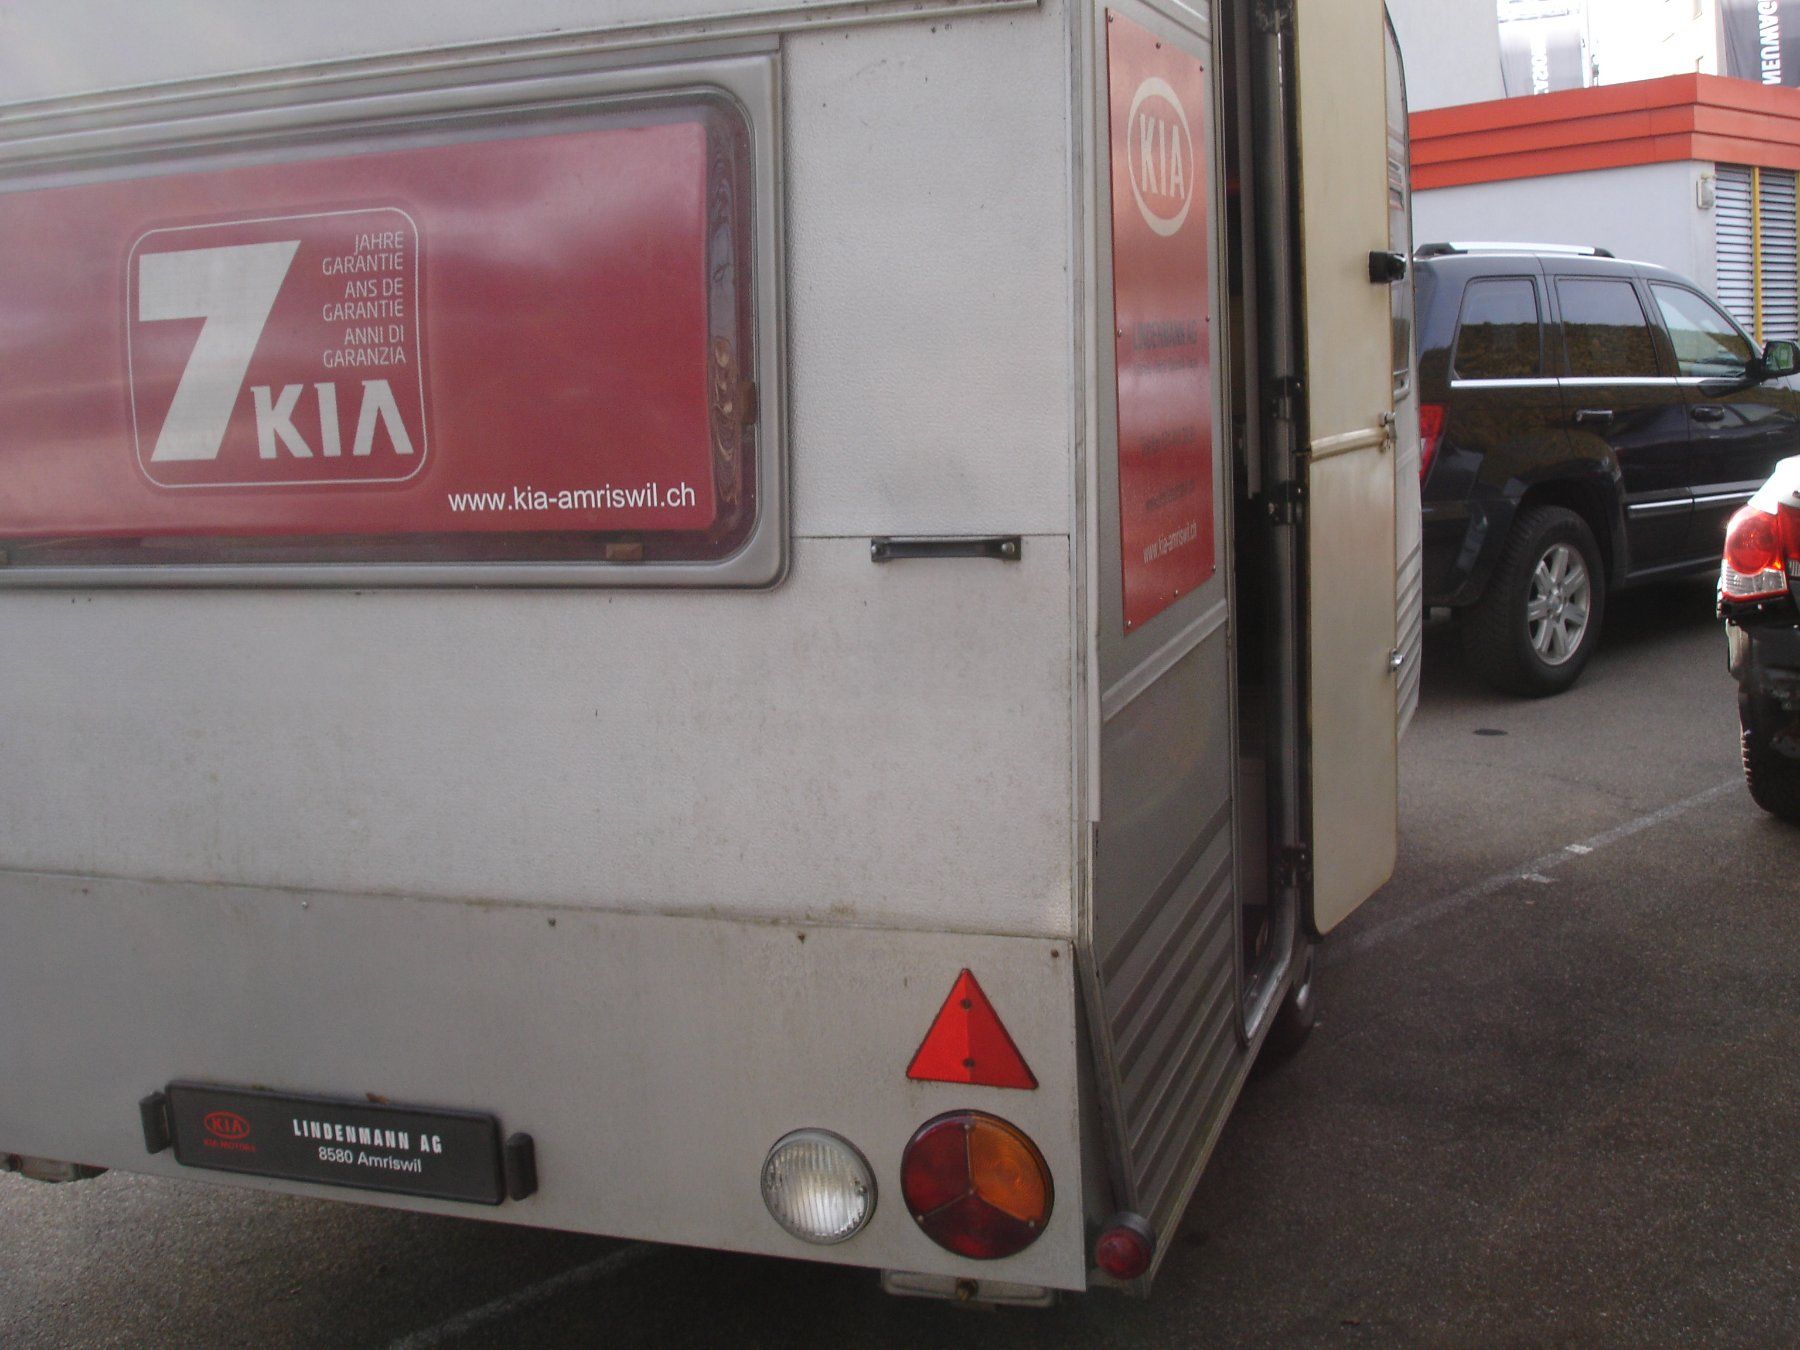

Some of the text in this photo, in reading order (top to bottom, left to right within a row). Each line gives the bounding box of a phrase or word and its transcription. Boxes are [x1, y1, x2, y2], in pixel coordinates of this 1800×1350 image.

[1139, 113, 1185, 200] KIA
[354, 231, 404, 256] JAHRE
[322, 252, 404, 276] GARANTIE
[344, 277, 404, 299] ANS DE
[322, 299, 404, 322] GARANTIE
[344, 324, 404, 346] ANNI DI
[139, 240, 301, 462] 7
[323, 346, 406, 368] GARANZIA
[250, 379, 414, 459] KIA
[448, 482, 696, 512] www.kia-amriswil.ch
[211, 1117, 243, 1133] KIA
[293, 1119, 442, 1153] LINDENMANN AG
[318, 1146, 422, 1173] 8580 Amriswil
